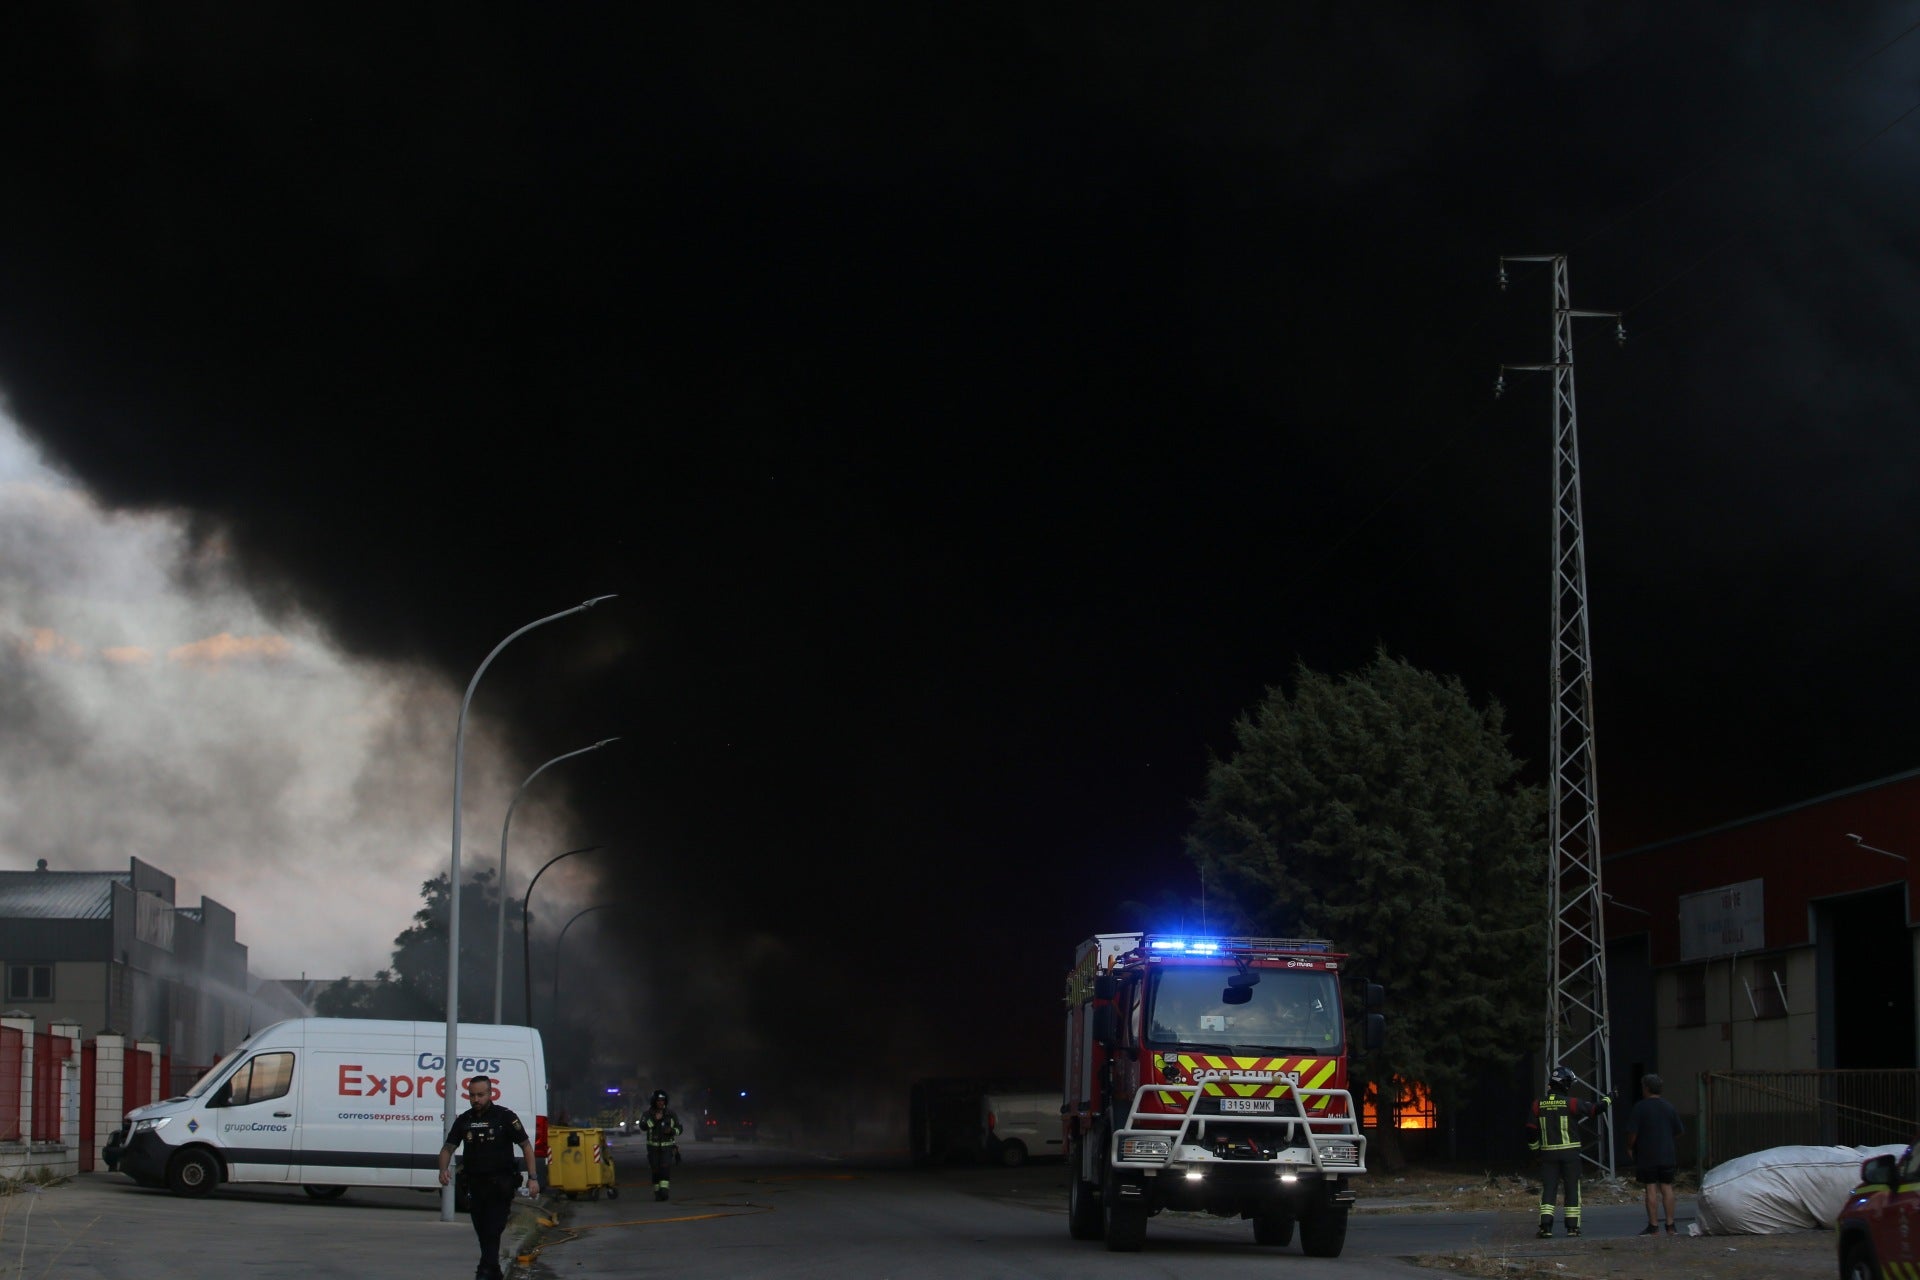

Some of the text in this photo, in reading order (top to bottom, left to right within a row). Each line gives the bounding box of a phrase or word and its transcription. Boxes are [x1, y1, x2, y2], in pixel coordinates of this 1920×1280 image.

[417, 1052, 501, 1074] Coreos
[1227, 1100, 1271, 1111] 3159 MMK
[338, 1112, 434, 1122] correosexpress.com
[224, 1122, 287, 1132] grupoCorreos
